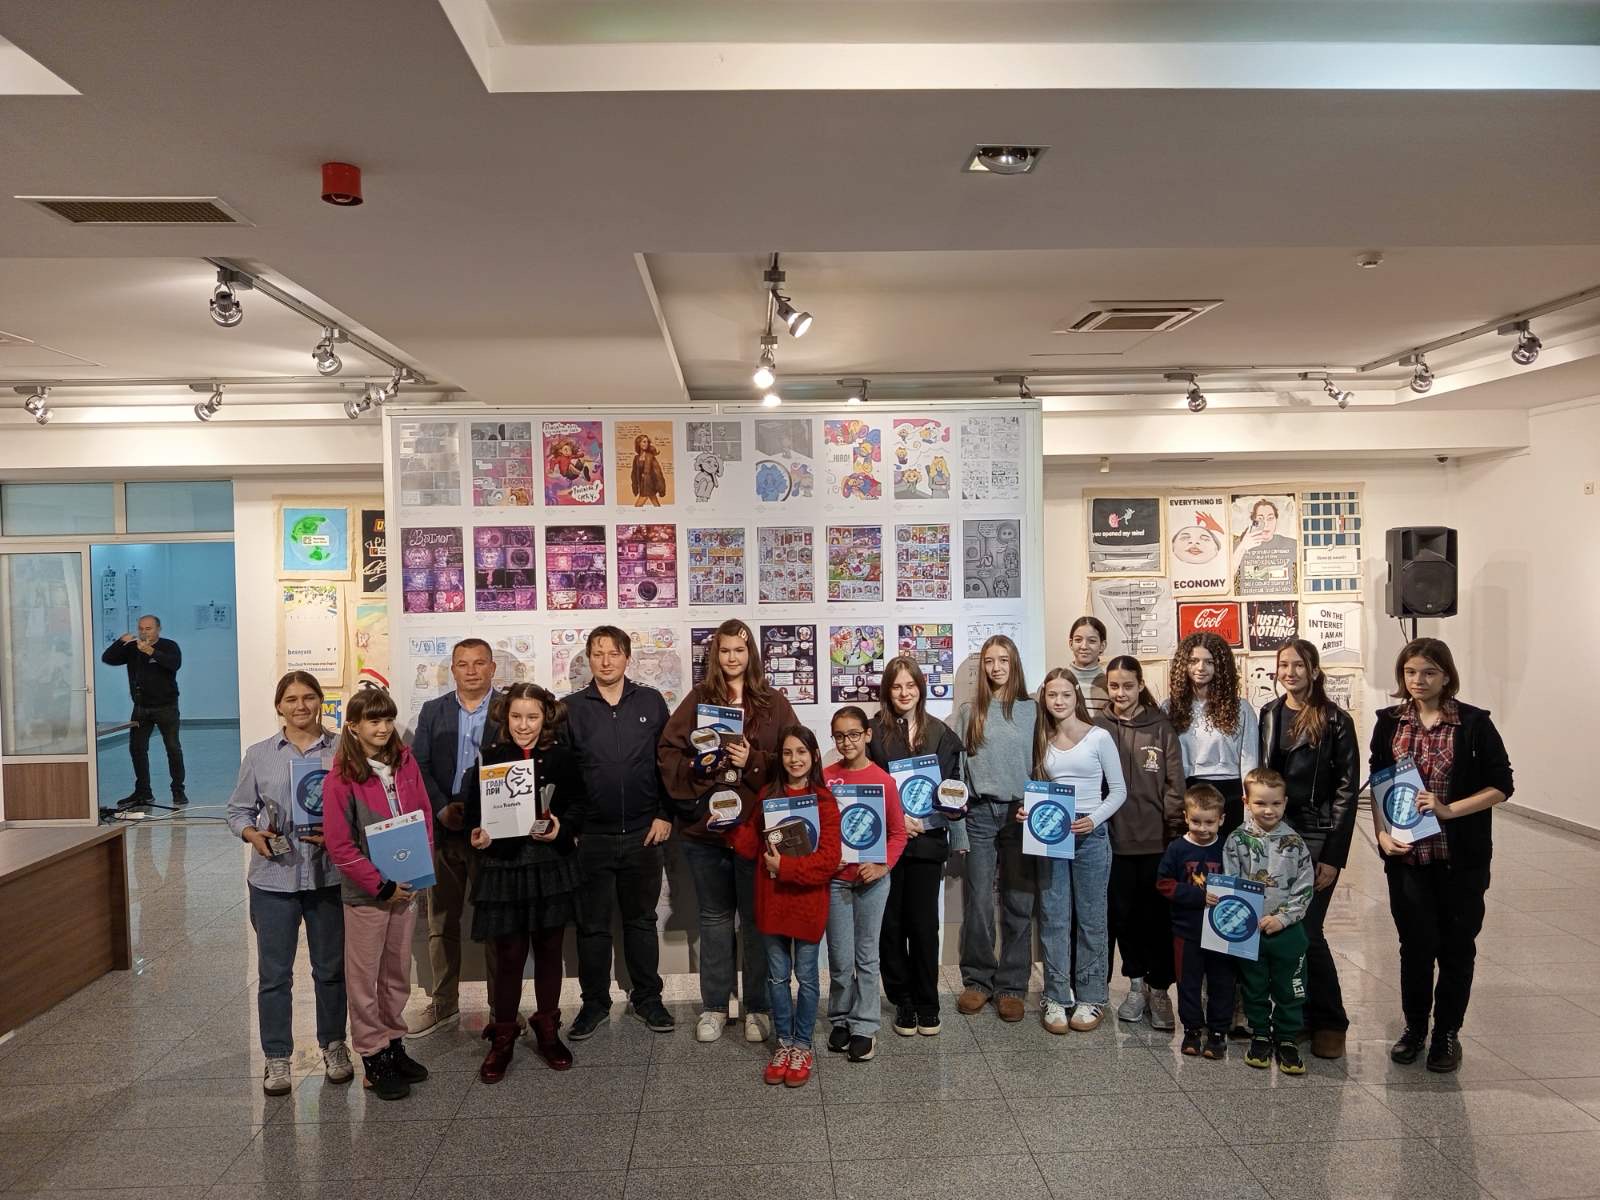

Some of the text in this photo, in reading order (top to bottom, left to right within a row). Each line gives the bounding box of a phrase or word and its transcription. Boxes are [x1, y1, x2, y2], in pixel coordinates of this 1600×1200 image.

[1102, 530, 1122, 538] opened
[1174, 580, 1226, 589] ECONOMY
[1194, 608, 1228, 628] Cool
[1320, 609, 1343, 620] ON THE
[1279, 616, 1295, 628] DO
[1309, 619, 1343, 629] INTERNET
[1250, 626, 1296, 637] NOTHING
[1322, 641, 1343, 651] ARTIST
[486, 787, 500, 796] ПРИ
